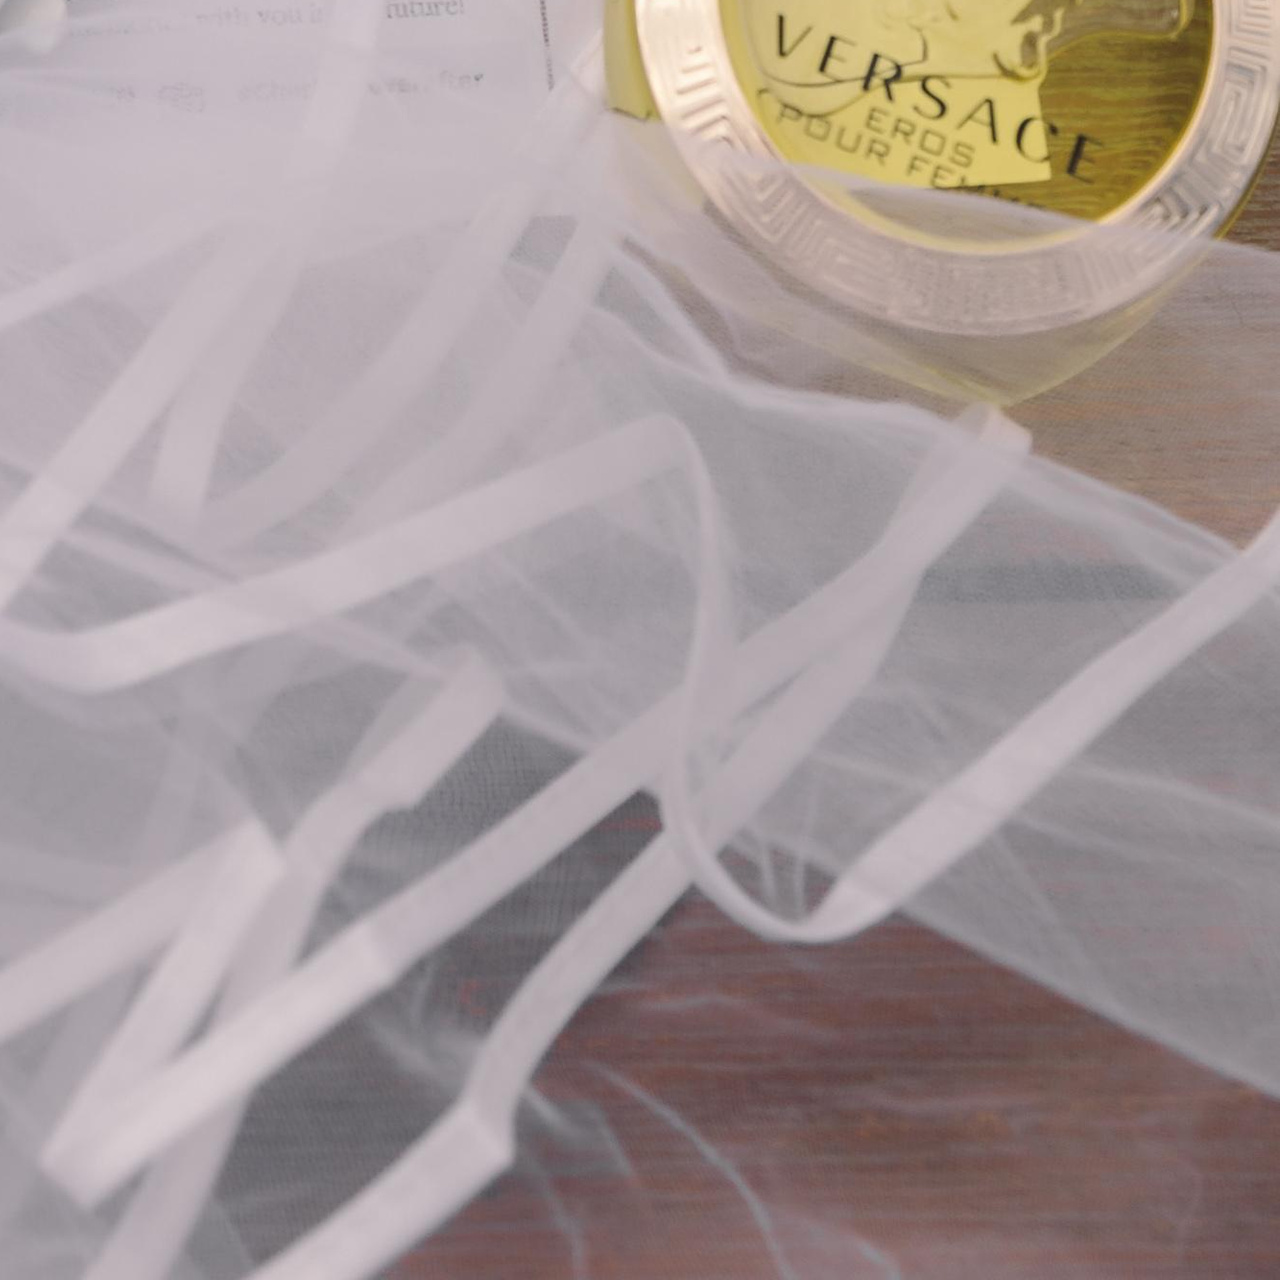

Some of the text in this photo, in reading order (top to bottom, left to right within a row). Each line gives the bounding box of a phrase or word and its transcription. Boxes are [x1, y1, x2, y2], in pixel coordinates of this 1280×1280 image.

[774, 13, 1106, 185] VERSACE
[778, 100, 893, 167] POUR
[865, 105, 976, 169] EROS
